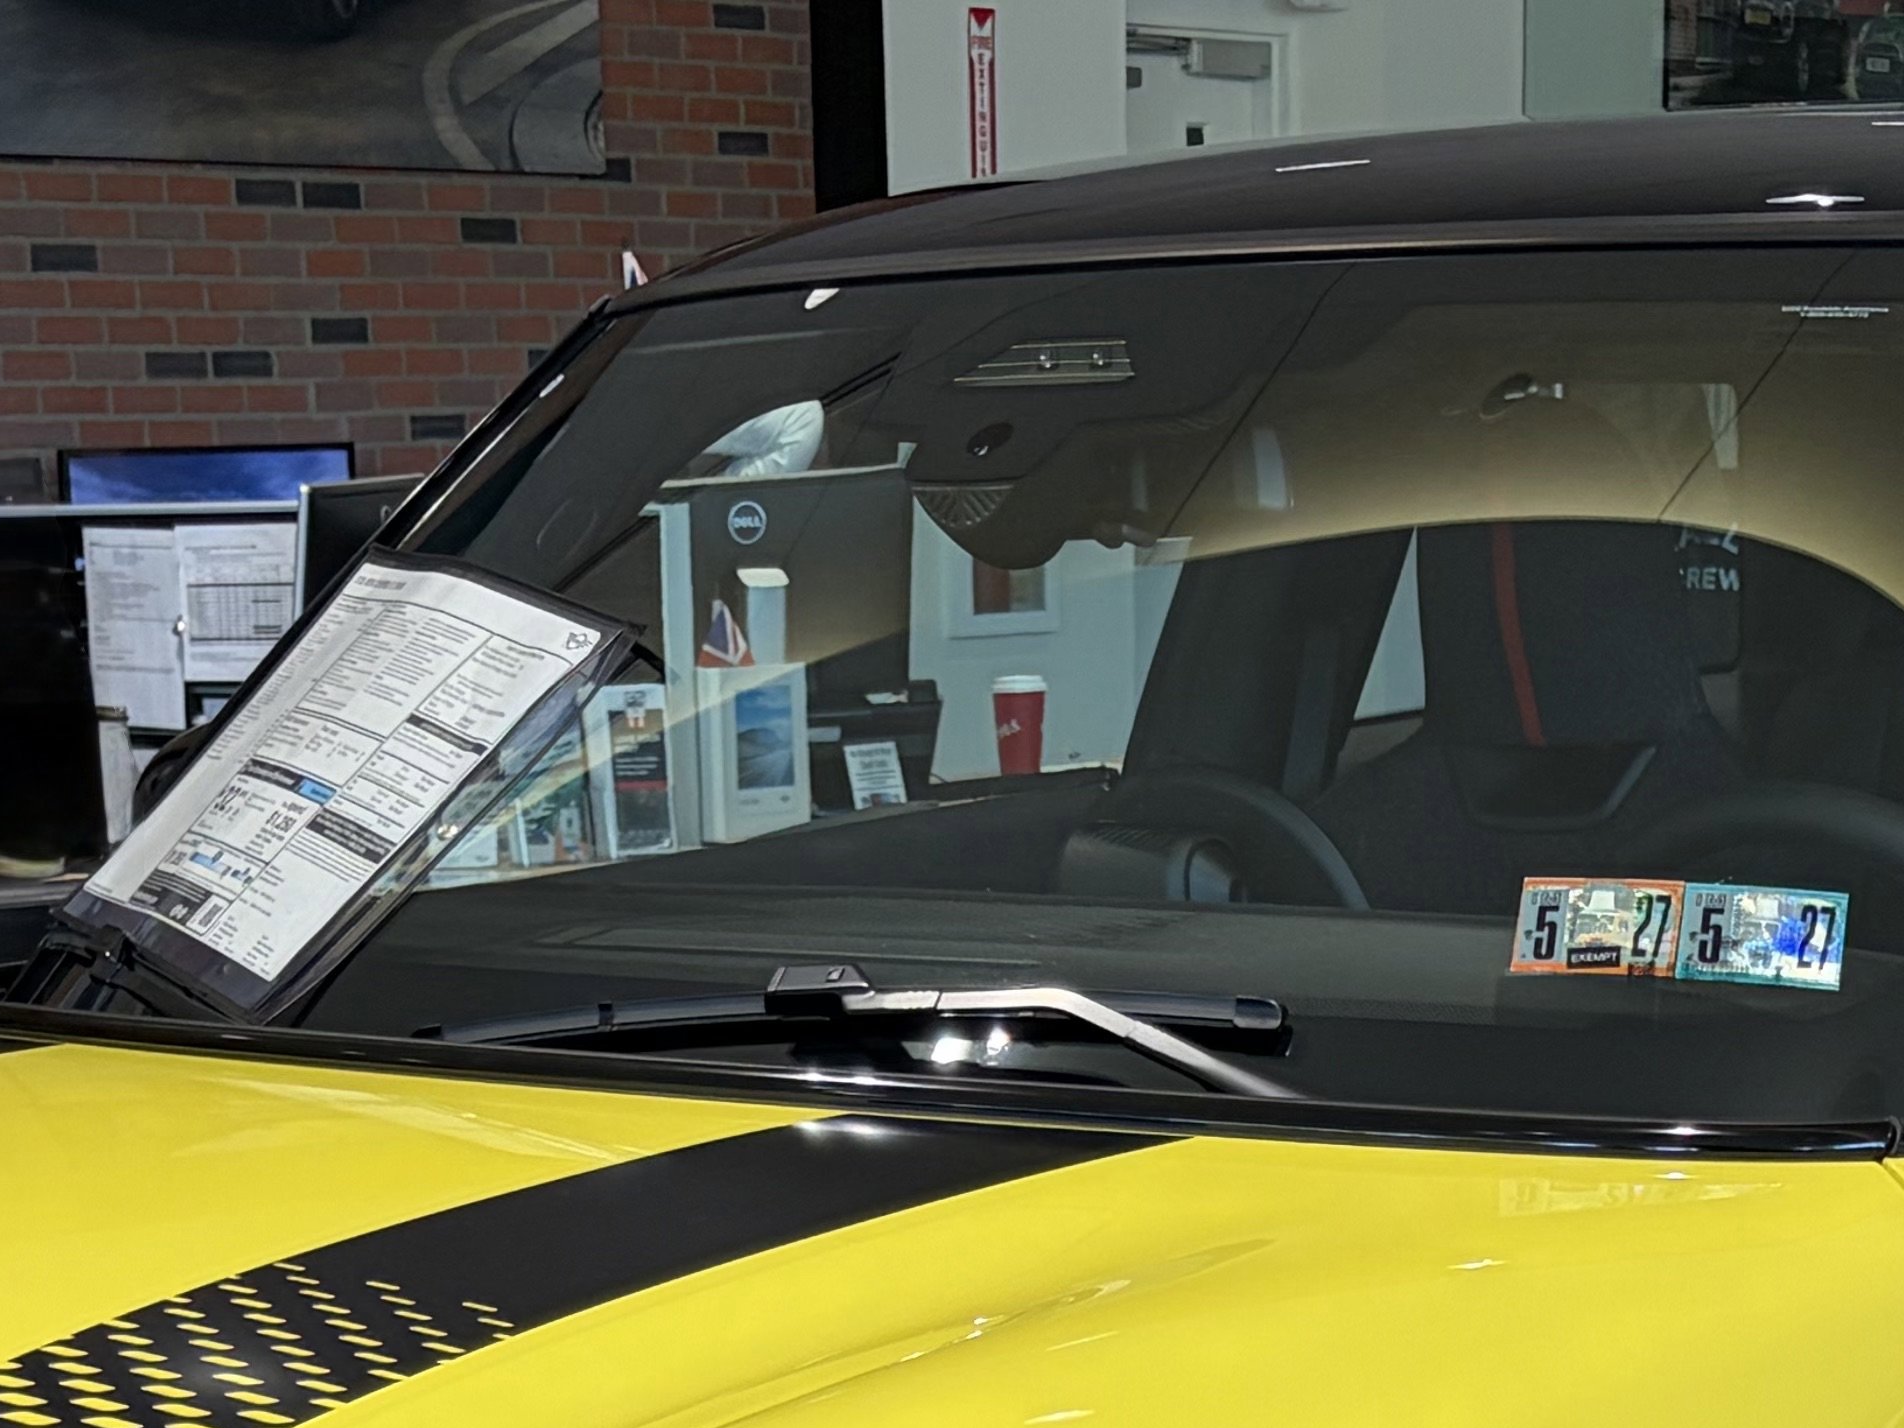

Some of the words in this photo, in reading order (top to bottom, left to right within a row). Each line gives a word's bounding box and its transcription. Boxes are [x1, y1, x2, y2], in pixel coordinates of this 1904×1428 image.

[1533, 905, 1560, 960] 5
[1631, 890, 1672, 958] 27
[1570, 950, 1618, 964] EXEMPT
[1698, 908, 1725, 964] 5
[1797, 904, 1836, 970] 27
